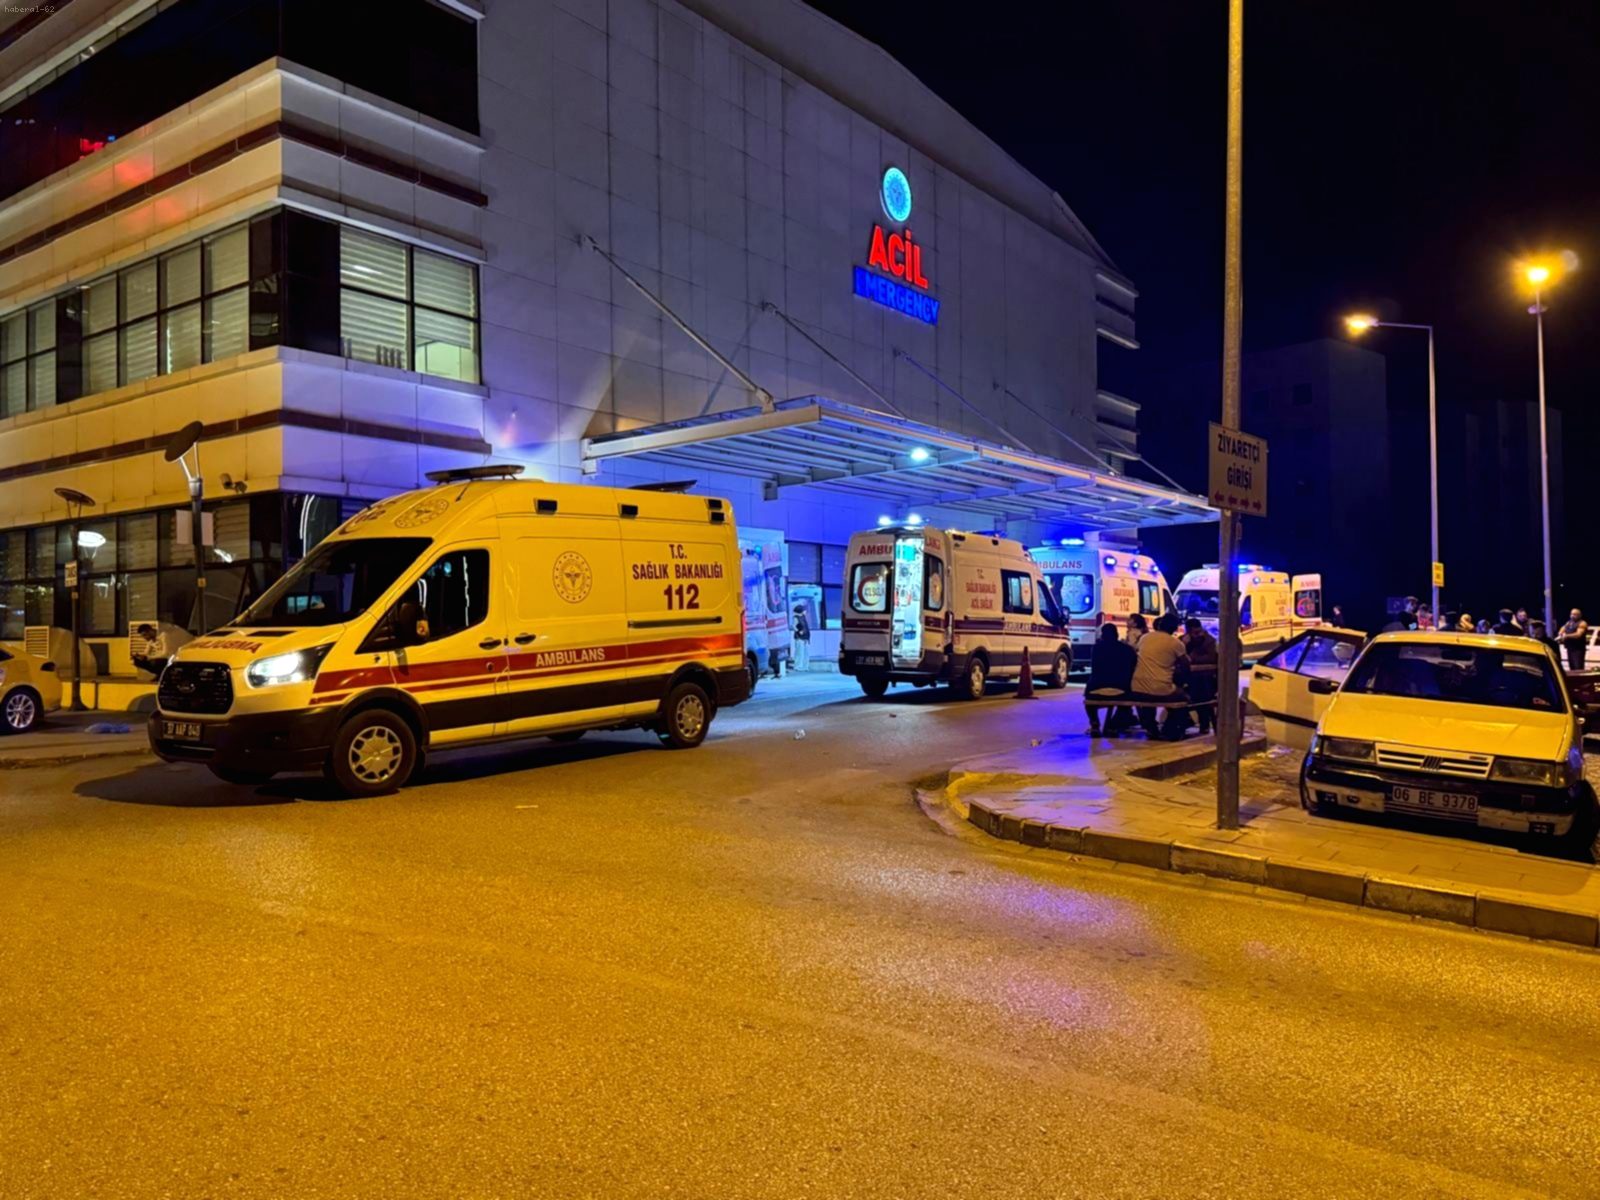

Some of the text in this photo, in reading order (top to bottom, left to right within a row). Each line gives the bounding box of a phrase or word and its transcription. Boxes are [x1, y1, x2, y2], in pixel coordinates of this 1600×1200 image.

[868, 225, 929, 290] ACİL
[855, 266, 940, 326] EMERGENCY
[1217, 430, 1261, 464] ZİYARETÇİ
[1227, 462, 1252, 491] GİRİŞİ
[669, 544, 687, 559] T.C.
[632, 561, 723, 580] SAĞLIK BAKANLIĞI
[1037, 560, 1082, 569] BULANS
[664, 584, 699, 610] 112
[536, 648, 605, 667] AMBULANS
[1394, 787, 1476, 811] 06 BE 9378
